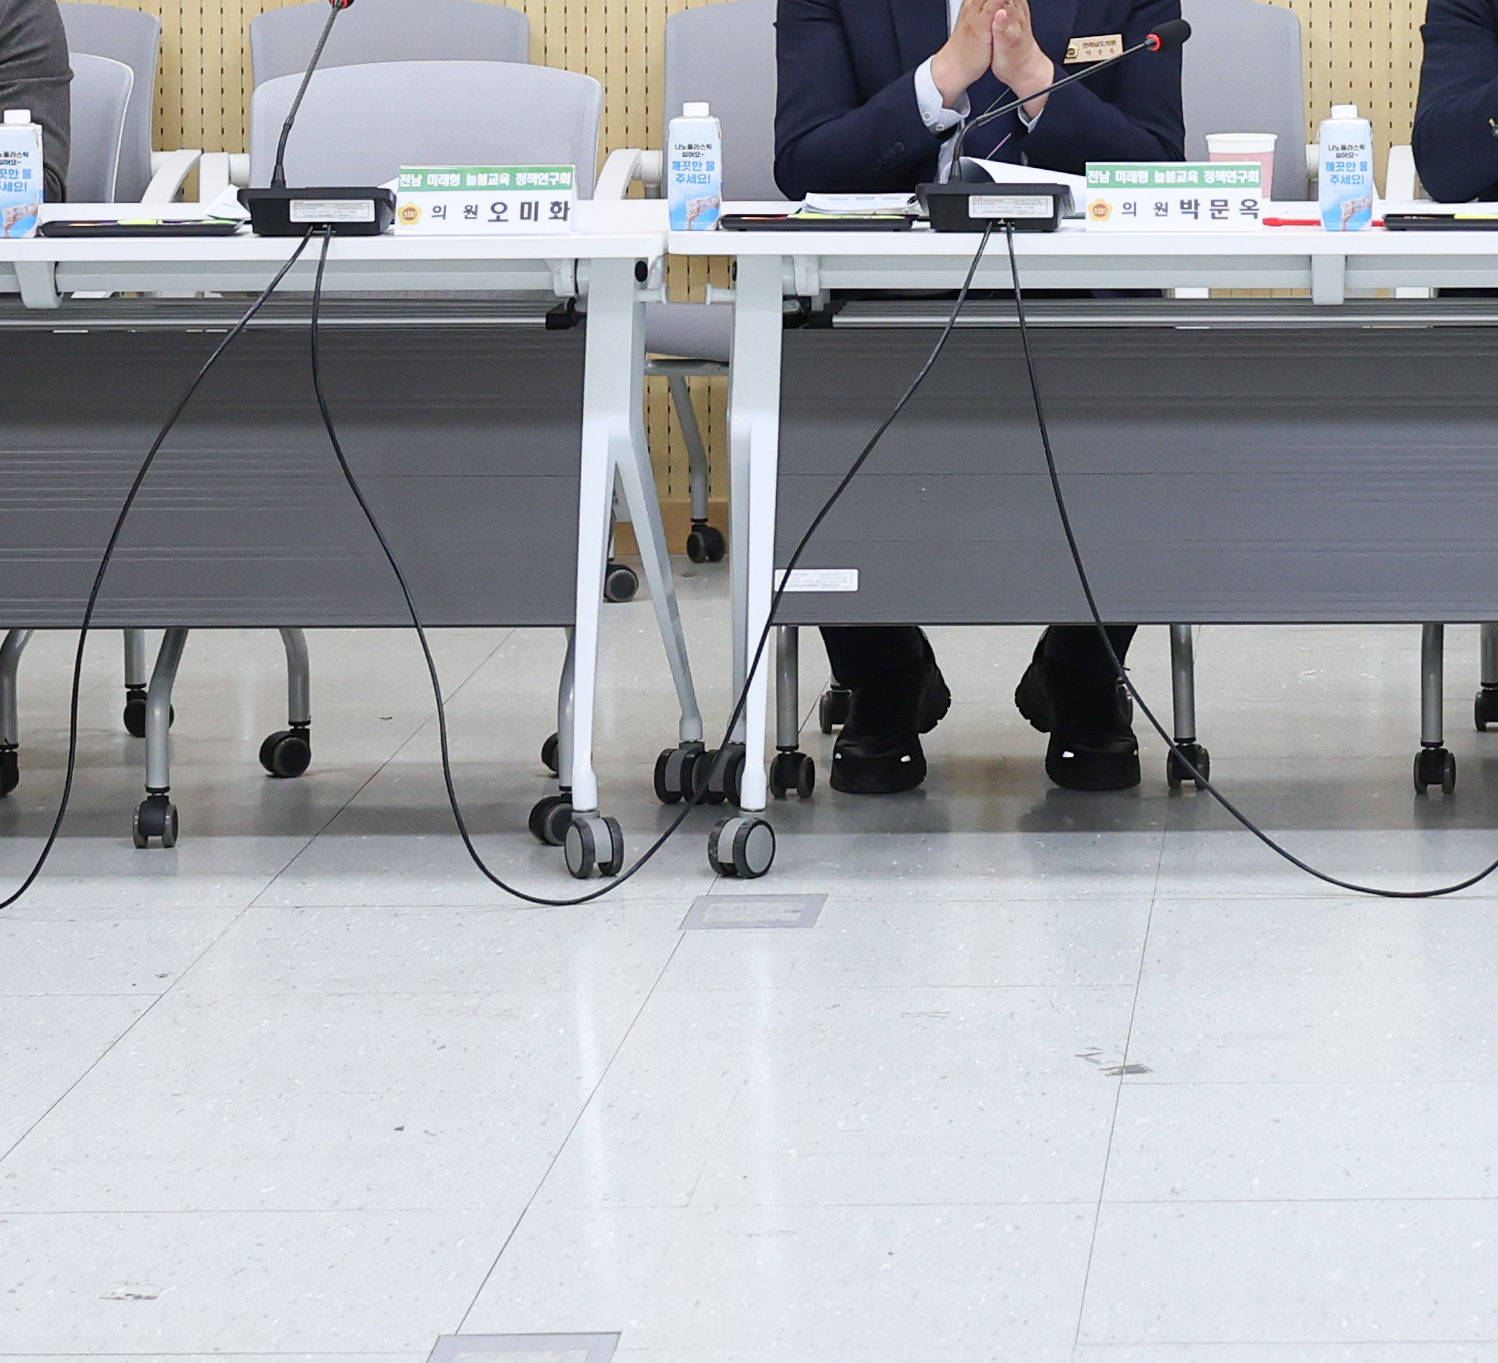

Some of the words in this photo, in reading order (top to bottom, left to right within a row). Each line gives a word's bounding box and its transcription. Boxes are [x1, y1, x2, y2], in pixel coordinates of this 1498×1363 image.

[671, 160, 702, 172] 깨끗한
[1326, 161, 1357, 173] 깨끗한
[399, 174, 424, 187] 전남
[427, 174, 461, 187] 미래형
[465, 173, 511, 187] 늘봄교육
[515, 171, 571, 186] 정책연구회
[676, 173, 711, 185] 주세요!
[1087, 170, 1110, 184] 전남
[1115, 170, 1149, 184] 미래형
[1154, 170, 1199, 184] 늘봄교육
[1203, 170, 1260, 184] 정책연구회
[1330, 174, 1365, 185] 주세요!
[487, 200, 571, 222] 오미화
[1179, 198, 1260, 220] 박문옥
